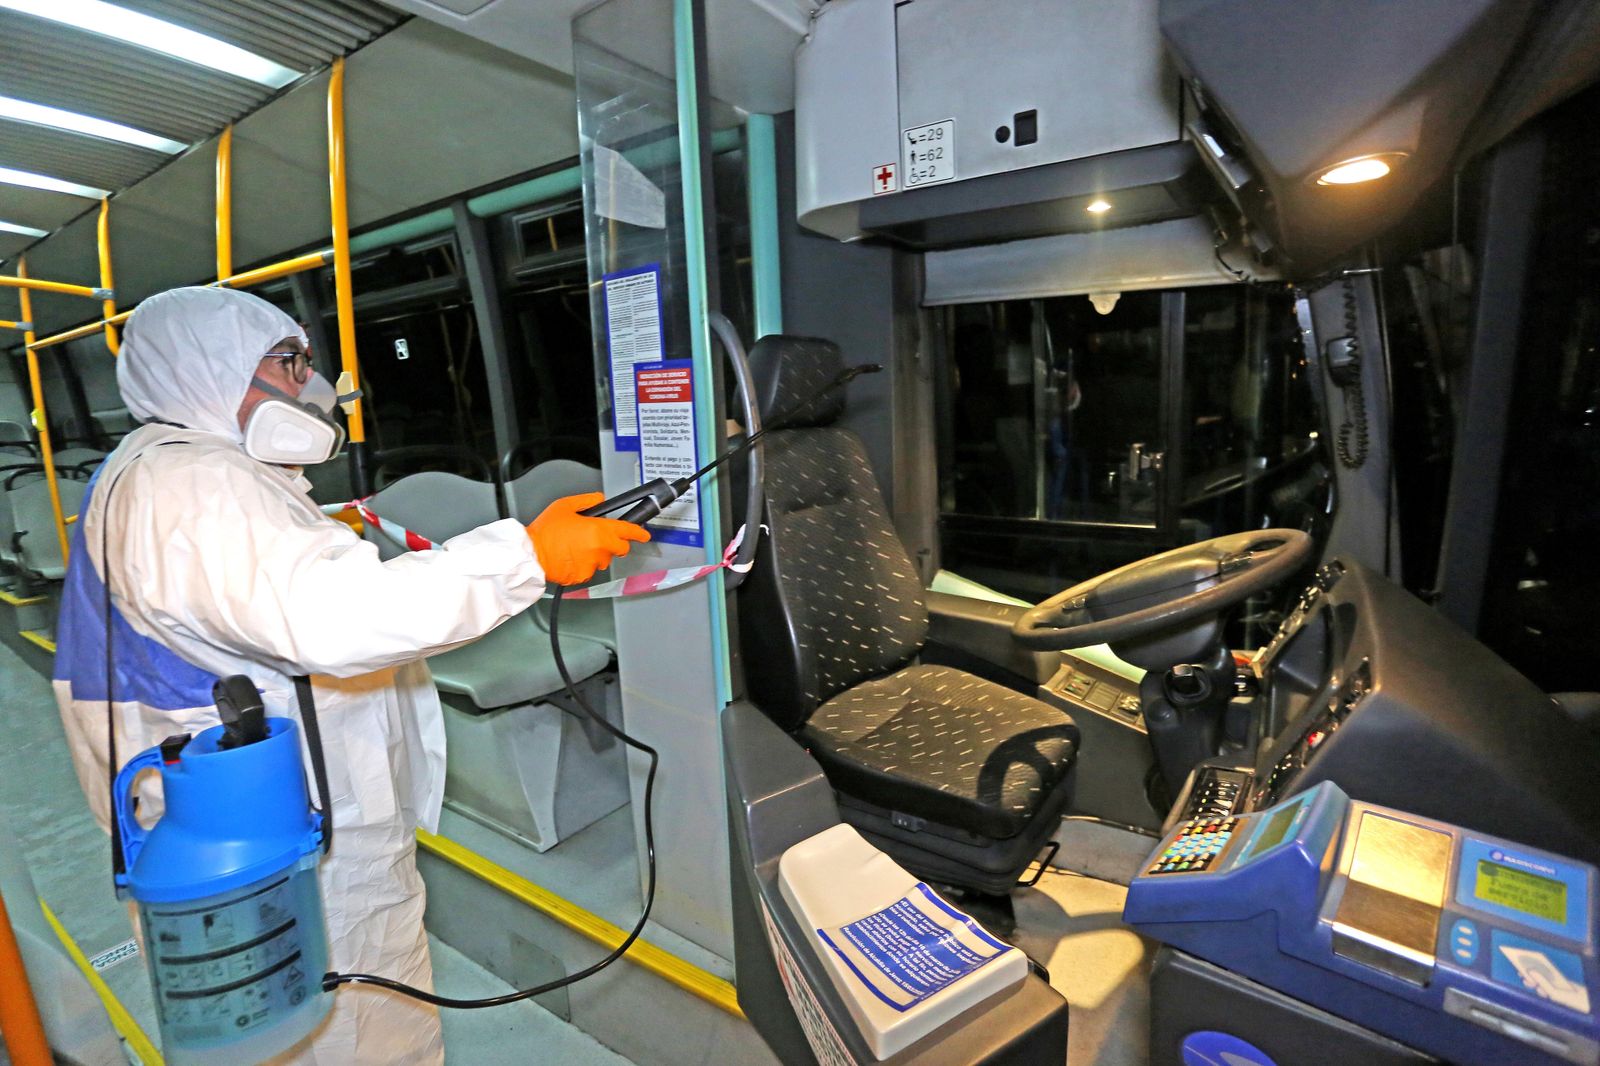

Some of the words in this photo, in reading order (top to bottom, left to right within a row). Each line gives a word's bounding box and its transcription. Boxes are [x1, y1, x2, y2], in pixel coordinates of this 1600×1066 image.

[867, 952, 886, 967] Alcaldía
[885, 950, 901, 963] donde
[914, 951, 934, 966] servicio
[927, 955, 944, 966] marzo
[902, 955, 920, 971] horario
[918, 970, 935, 982] normal
